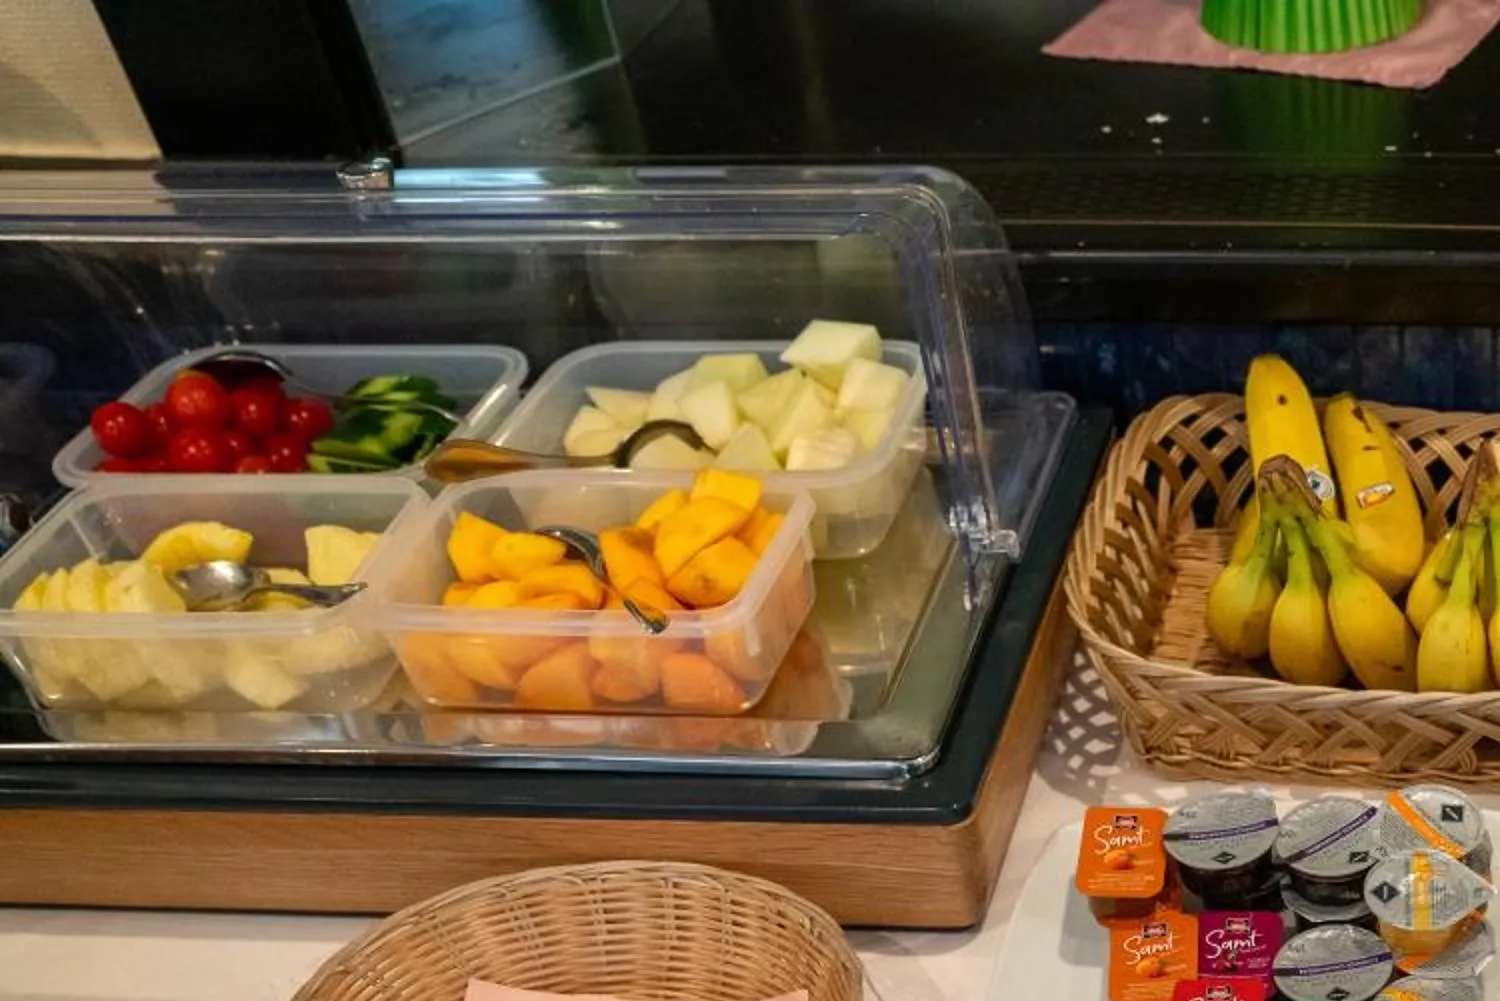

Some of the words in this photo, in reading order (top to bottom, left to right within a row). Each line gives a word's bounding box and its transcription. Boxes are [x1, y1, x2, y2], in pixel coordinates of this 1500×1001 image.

[1094, 825, 1151, 854] Samt
[1124, 933, 1181, 964] Samt
[1205, 929, 1263, 958] Samt
